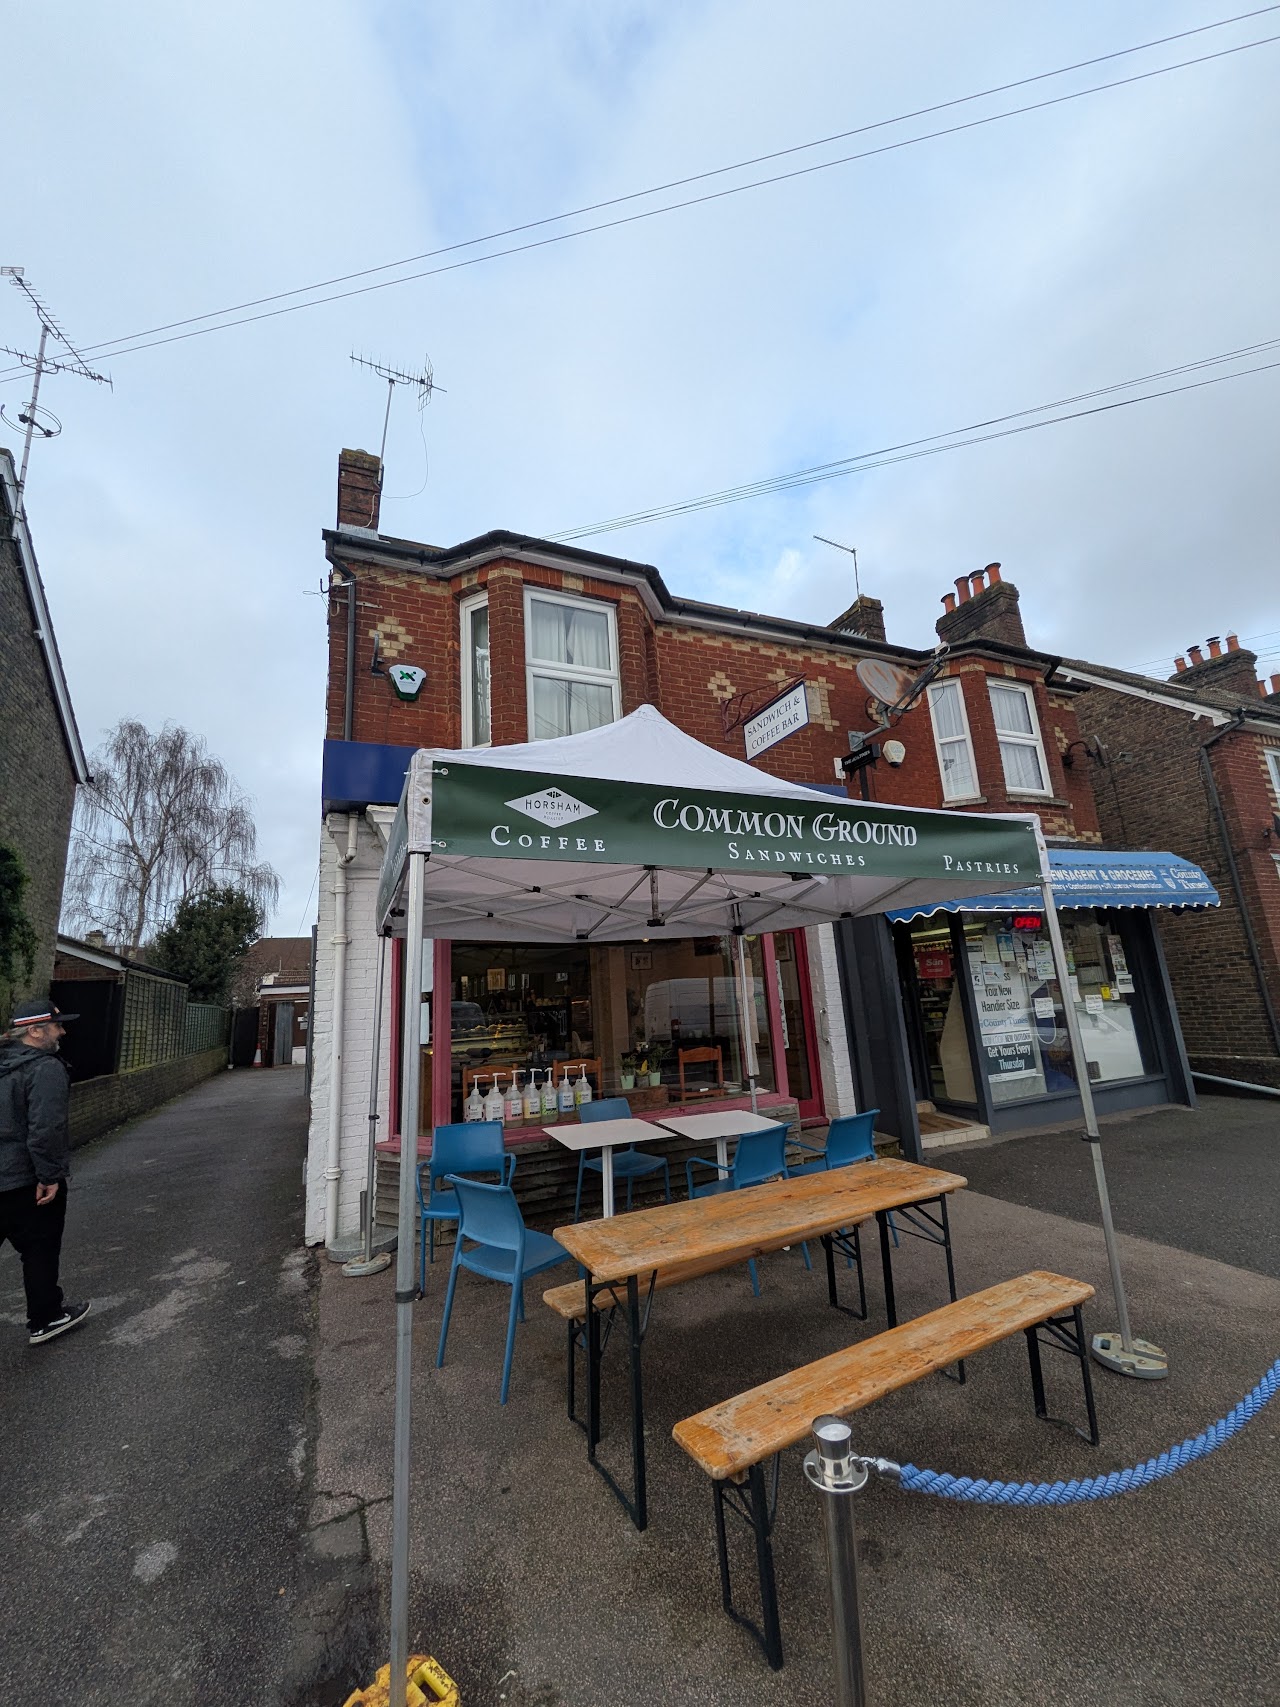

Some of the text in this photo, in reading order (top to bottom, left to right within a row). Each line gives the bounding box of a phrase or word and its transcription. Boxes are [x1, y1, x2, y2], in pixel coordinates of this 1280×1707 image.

[747, 695, 801, 737] SANDWICH &
[751, 712, 799, 749] COFFEE BAR
[525, 799, 581, 814] HORSHAM
[653, 798, 917, 846] COMMON GROUND
[490, 825, 605, 852] COFFEE
[728, 842, 865, 866] SANDWICHES
[943, 855, 1019, 874] PASTRIES
[1049, 869, 1158, 881] EWSAGENT & GROCERIES
[1169, 867, 1202, 880] County
[1177, 879, 1208, 889] Times
[1014, 917, 1041, 929] OPEN
[985, 985, 1012, 997] Your New
[1006, 999, 1020, 1010] Size
[983, 1016, 1029, 1028] County Times
[988, 1043, 1031, 1057] Get Yours Every
[998, 1057, 1025, 1070] Thursday
